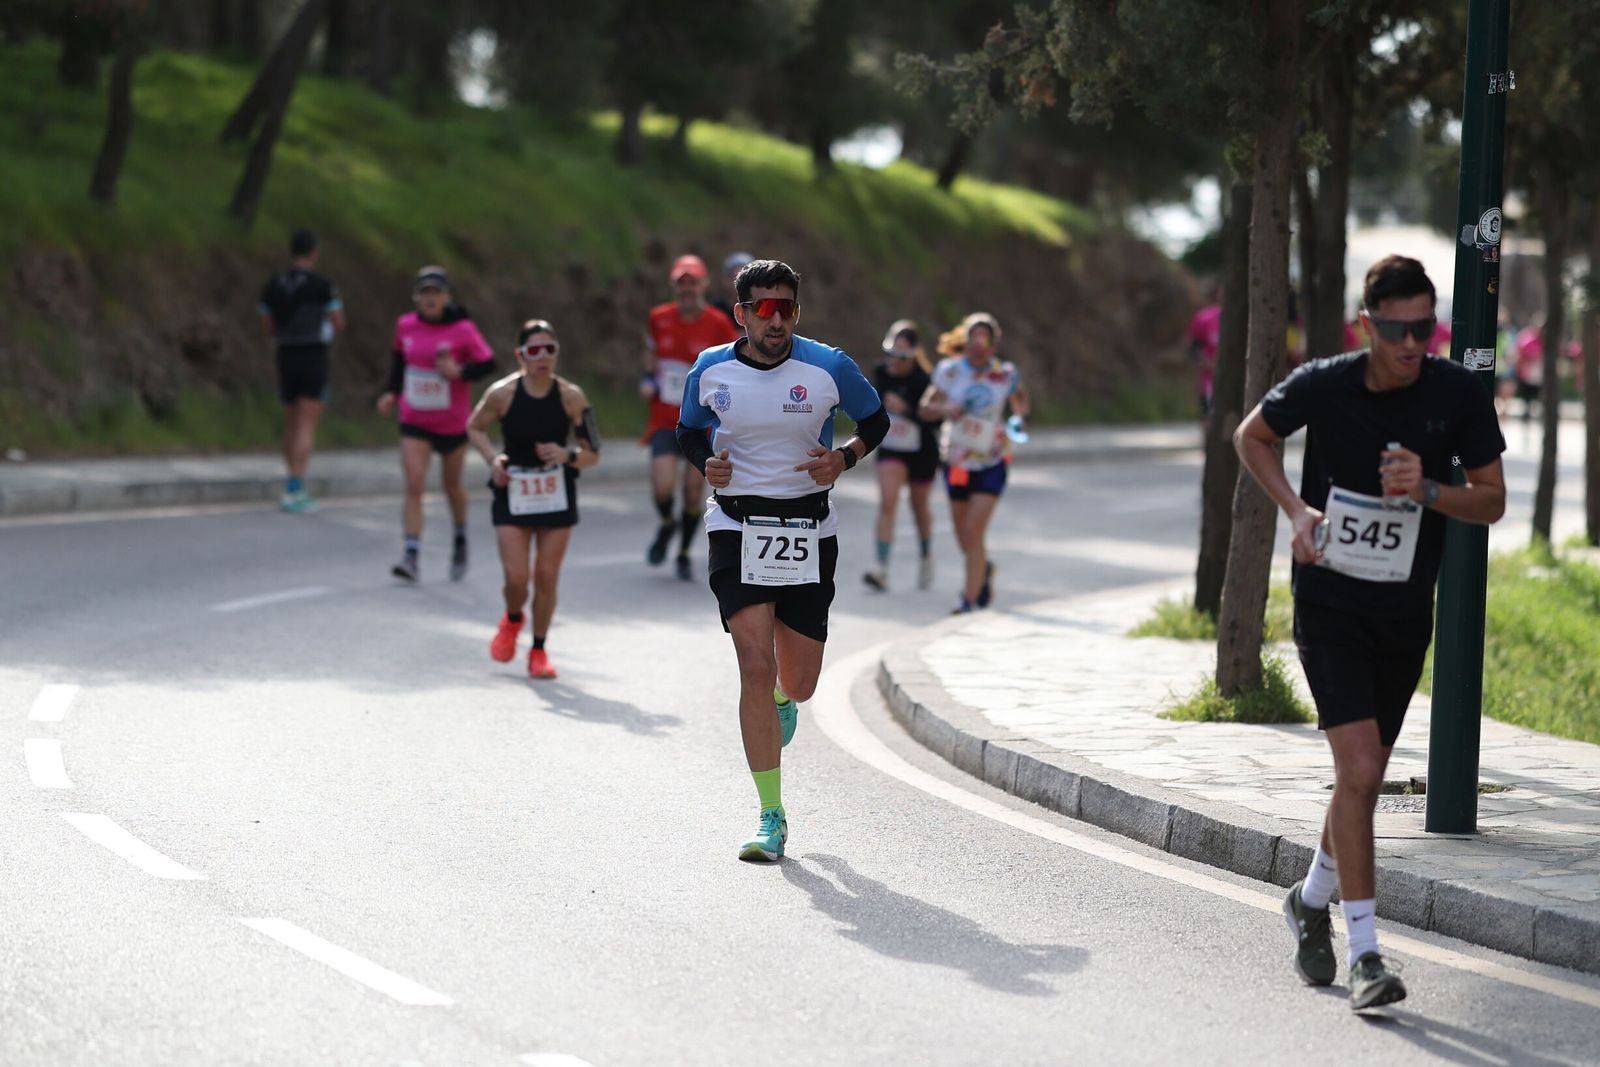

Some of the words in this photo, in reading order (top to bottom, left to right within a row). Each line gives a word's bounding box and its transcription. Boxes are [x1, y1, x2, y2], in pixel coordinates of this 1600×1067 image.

[520, 476, 557, 497] 118
[1338, 514, 1403, 550] 545
[756, 535, 809, 562] 725
